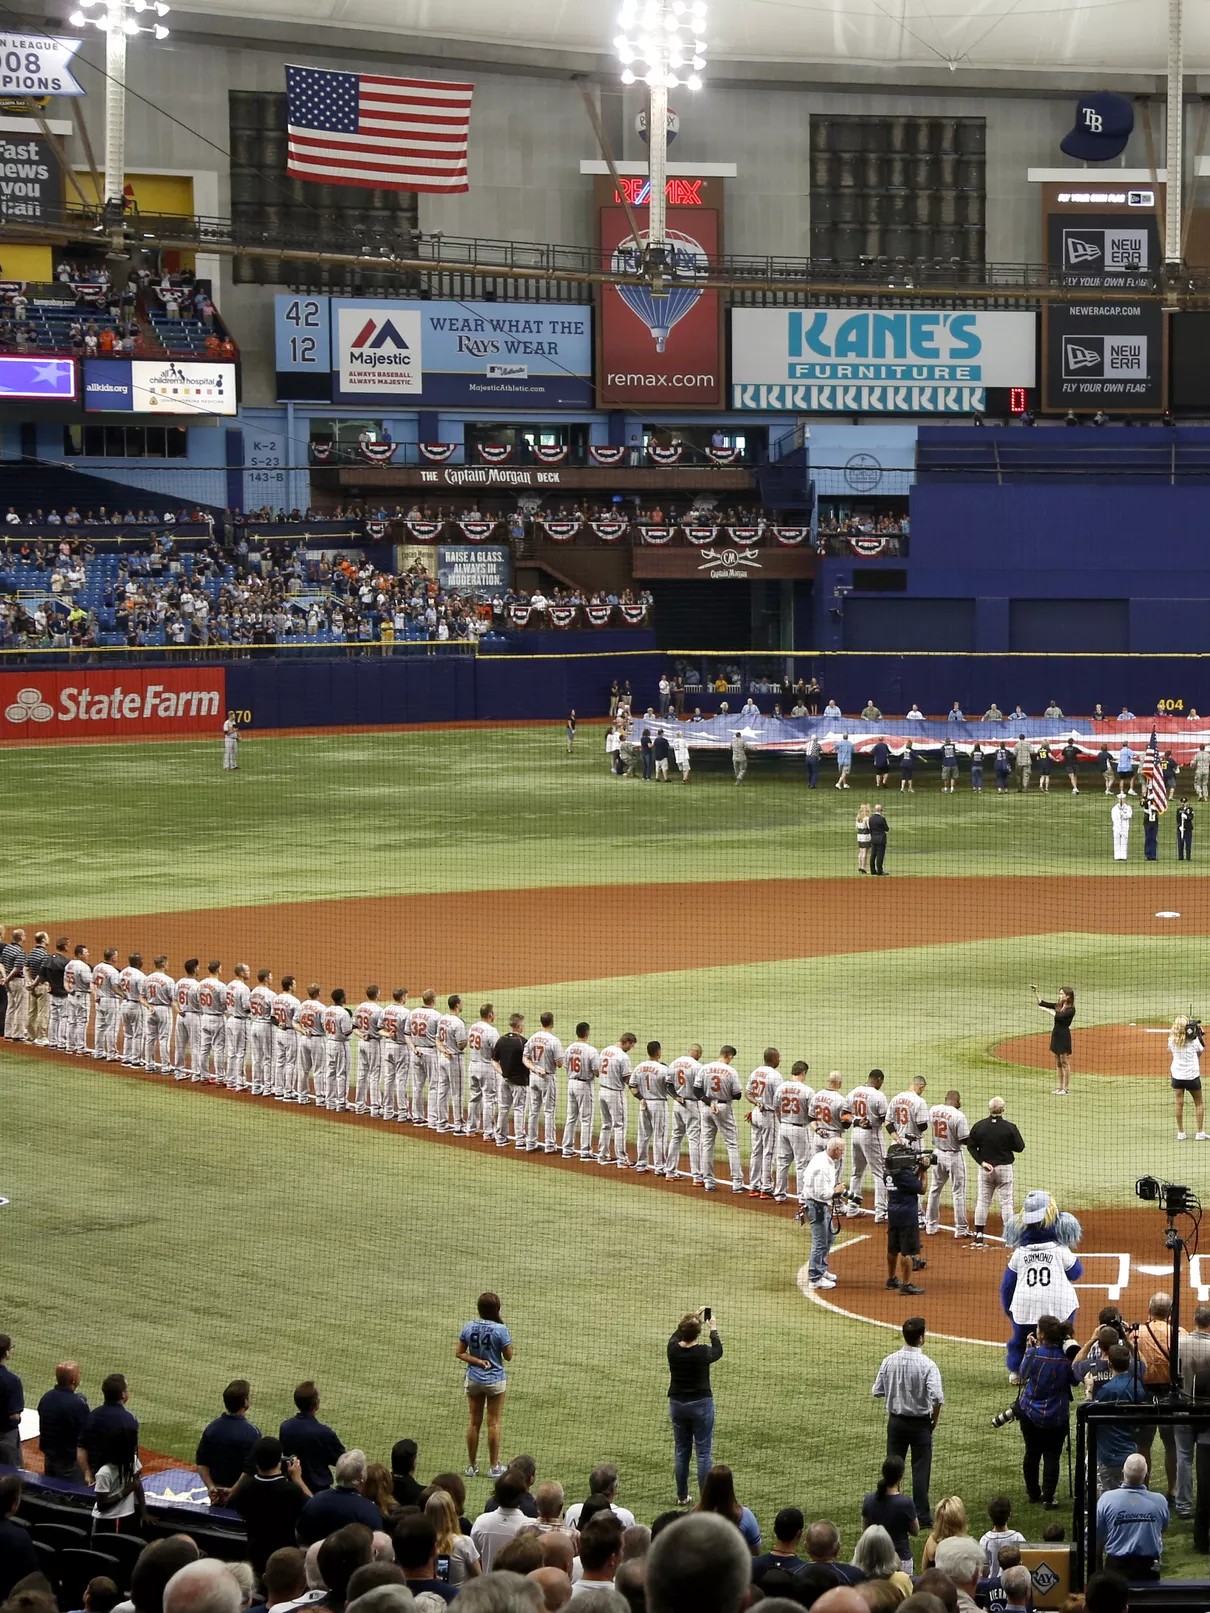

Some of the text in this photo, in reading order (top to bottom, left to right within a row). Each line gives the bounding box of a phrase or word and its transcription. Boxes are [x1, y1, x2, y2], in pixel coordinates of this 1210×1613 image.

[13, 40, 59, 50] LEAGUE
[0, 51, 41, 74] 08
[1083, 108, 1103, 132] TB
[1111, 239, 1141, 251] NEW
[1111, 251, 1141, 263] ERA
[1104, 278, 1125, 286] OWN
[285, 300, 320, 328] 42
[1069, 306, 1141, 316] NEWERACAP.COM
[429, 317, 584, 335] WEAR WHAT THE
[788, 311, 982, 359] KANE'S
[289, 336, 317, 363] 12
[457, 334, 559, 358] RAYS WEAR
[1111, 345, 1141, 357] NEW
[350, 352, 411, 368] Majestic
[1111, 357, 1141, 369] ERA
[607, 371, 715, 388] remax.com
[795, 365, 971, 380] FURNITURE
[86, 383, 128, 394] allkids.org
[186, 378, 215, 387] hospital
[469, 384, 545, 393] MajesticAthletic.com
[1062, 383, 1147, 393] FLY YOUR OWN FLAG
[253, 442, 276, 451] K-2
[251, 457, 280, 466] S-23
[248, 473, 284, 482] 143-B
[420, 468, 560, 485] THE Captain Morgan DECK
[445, 552, 504, 562] RAISE A GLASS.
[453, 563, 496, 574] ALWAYS IN
[448, 574, 502, 586] MODERATION.
[1158, 698, 1184, 711] 404
[412, 1021, 427, 1037] 32
[469, 1033, 481, 1050] 29
[532, 1045, 544, 1061] 17
[569, 1056, 581, 1073] 16
[601, 1058, 609, 1075] 2
[677, 1069, 686, 1086] 6
[711, 1075, 721, 1093] 3
[751, 1079, 766, 1098] 27
[781, 1097, 801, 1114] 23
[853, 1100, 867, 1118] 10
[815, 1105, 832, 1124] 28
[895, 1107, 909, 1125] 13
[932, 1120, 948, 1139] 12
[1023, 1253, 1053, 1264] RAYMOND
[1027, 1267, 1051, 1287] 00
[469, 1332, 492, 1350] 94
[1117, 1510, 1157, 1521] Security
